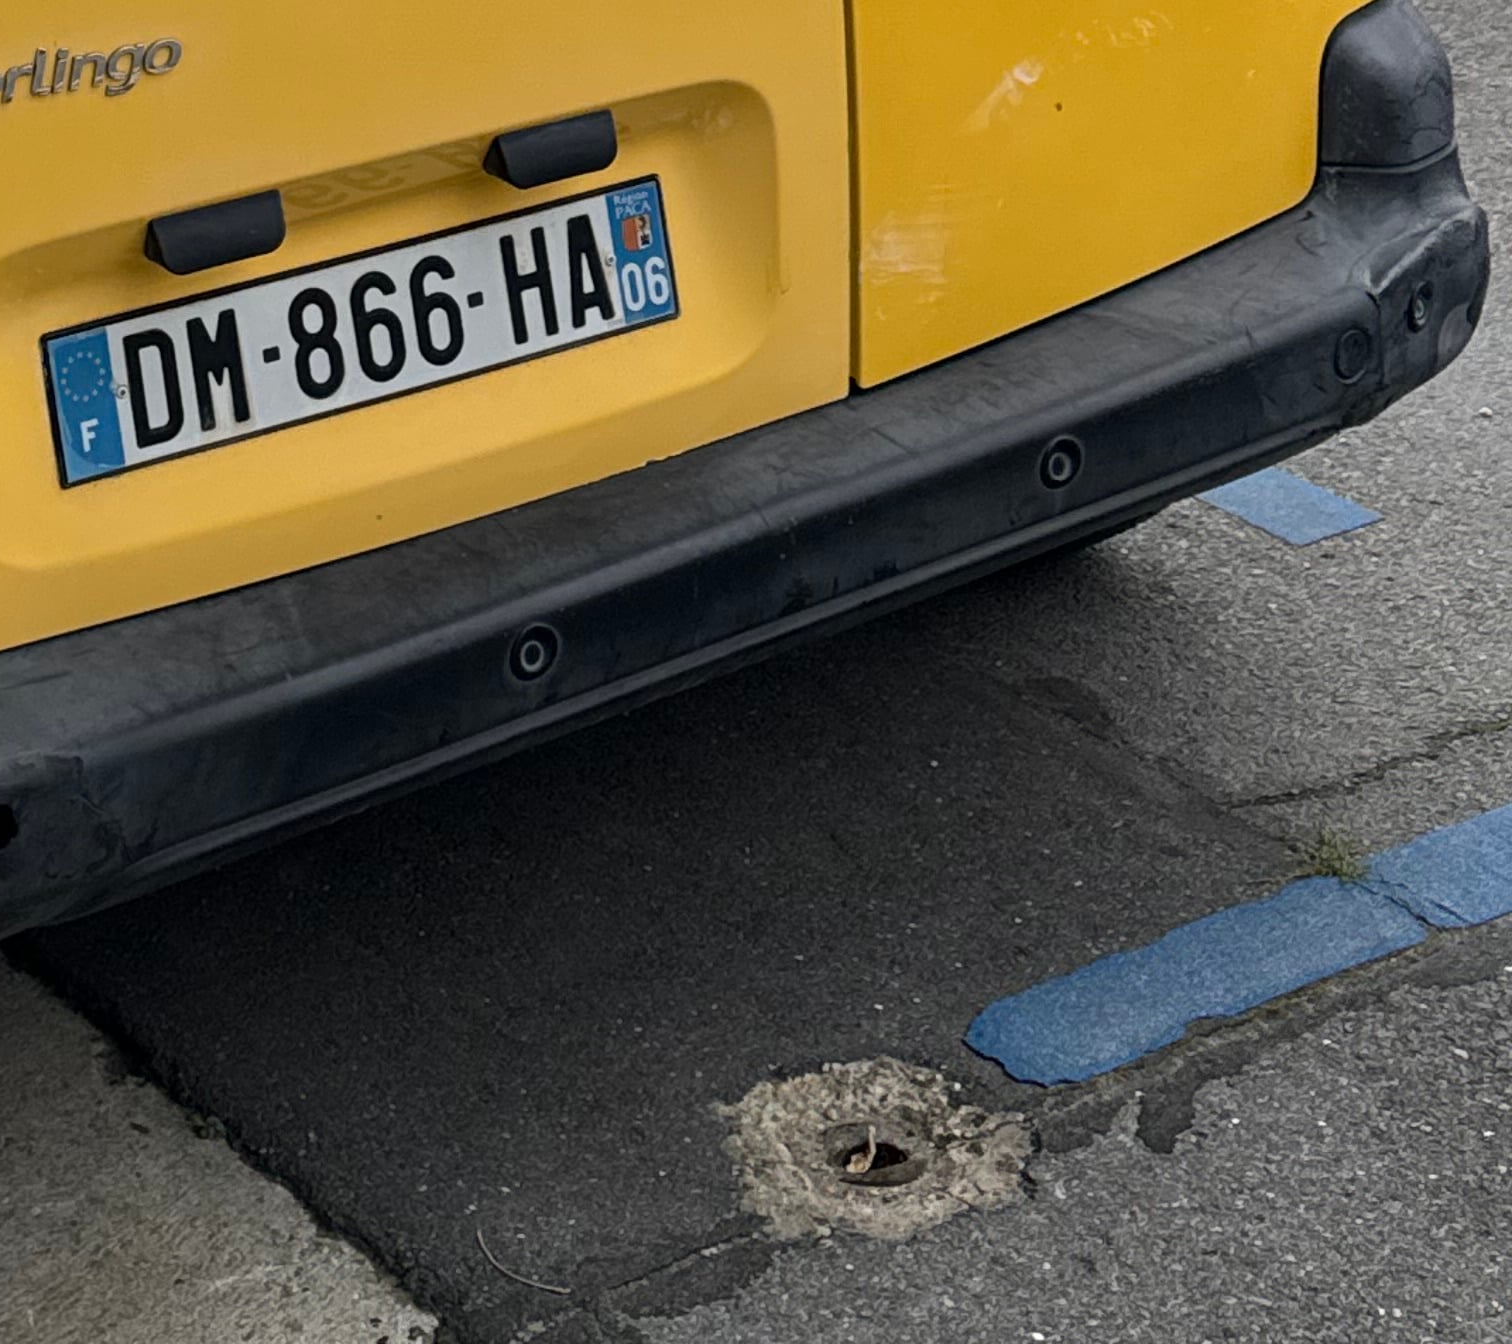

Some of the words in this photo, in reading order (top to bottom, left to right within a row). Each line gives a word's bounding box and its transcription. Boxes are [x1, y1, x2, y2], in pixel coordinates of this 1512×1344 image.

[615, 201, 651, 220] PACA
[621, 256, 670, 311] 06
[122, 213, 616, 449] DM-866-HA
[79, 418, 99, 453] F
